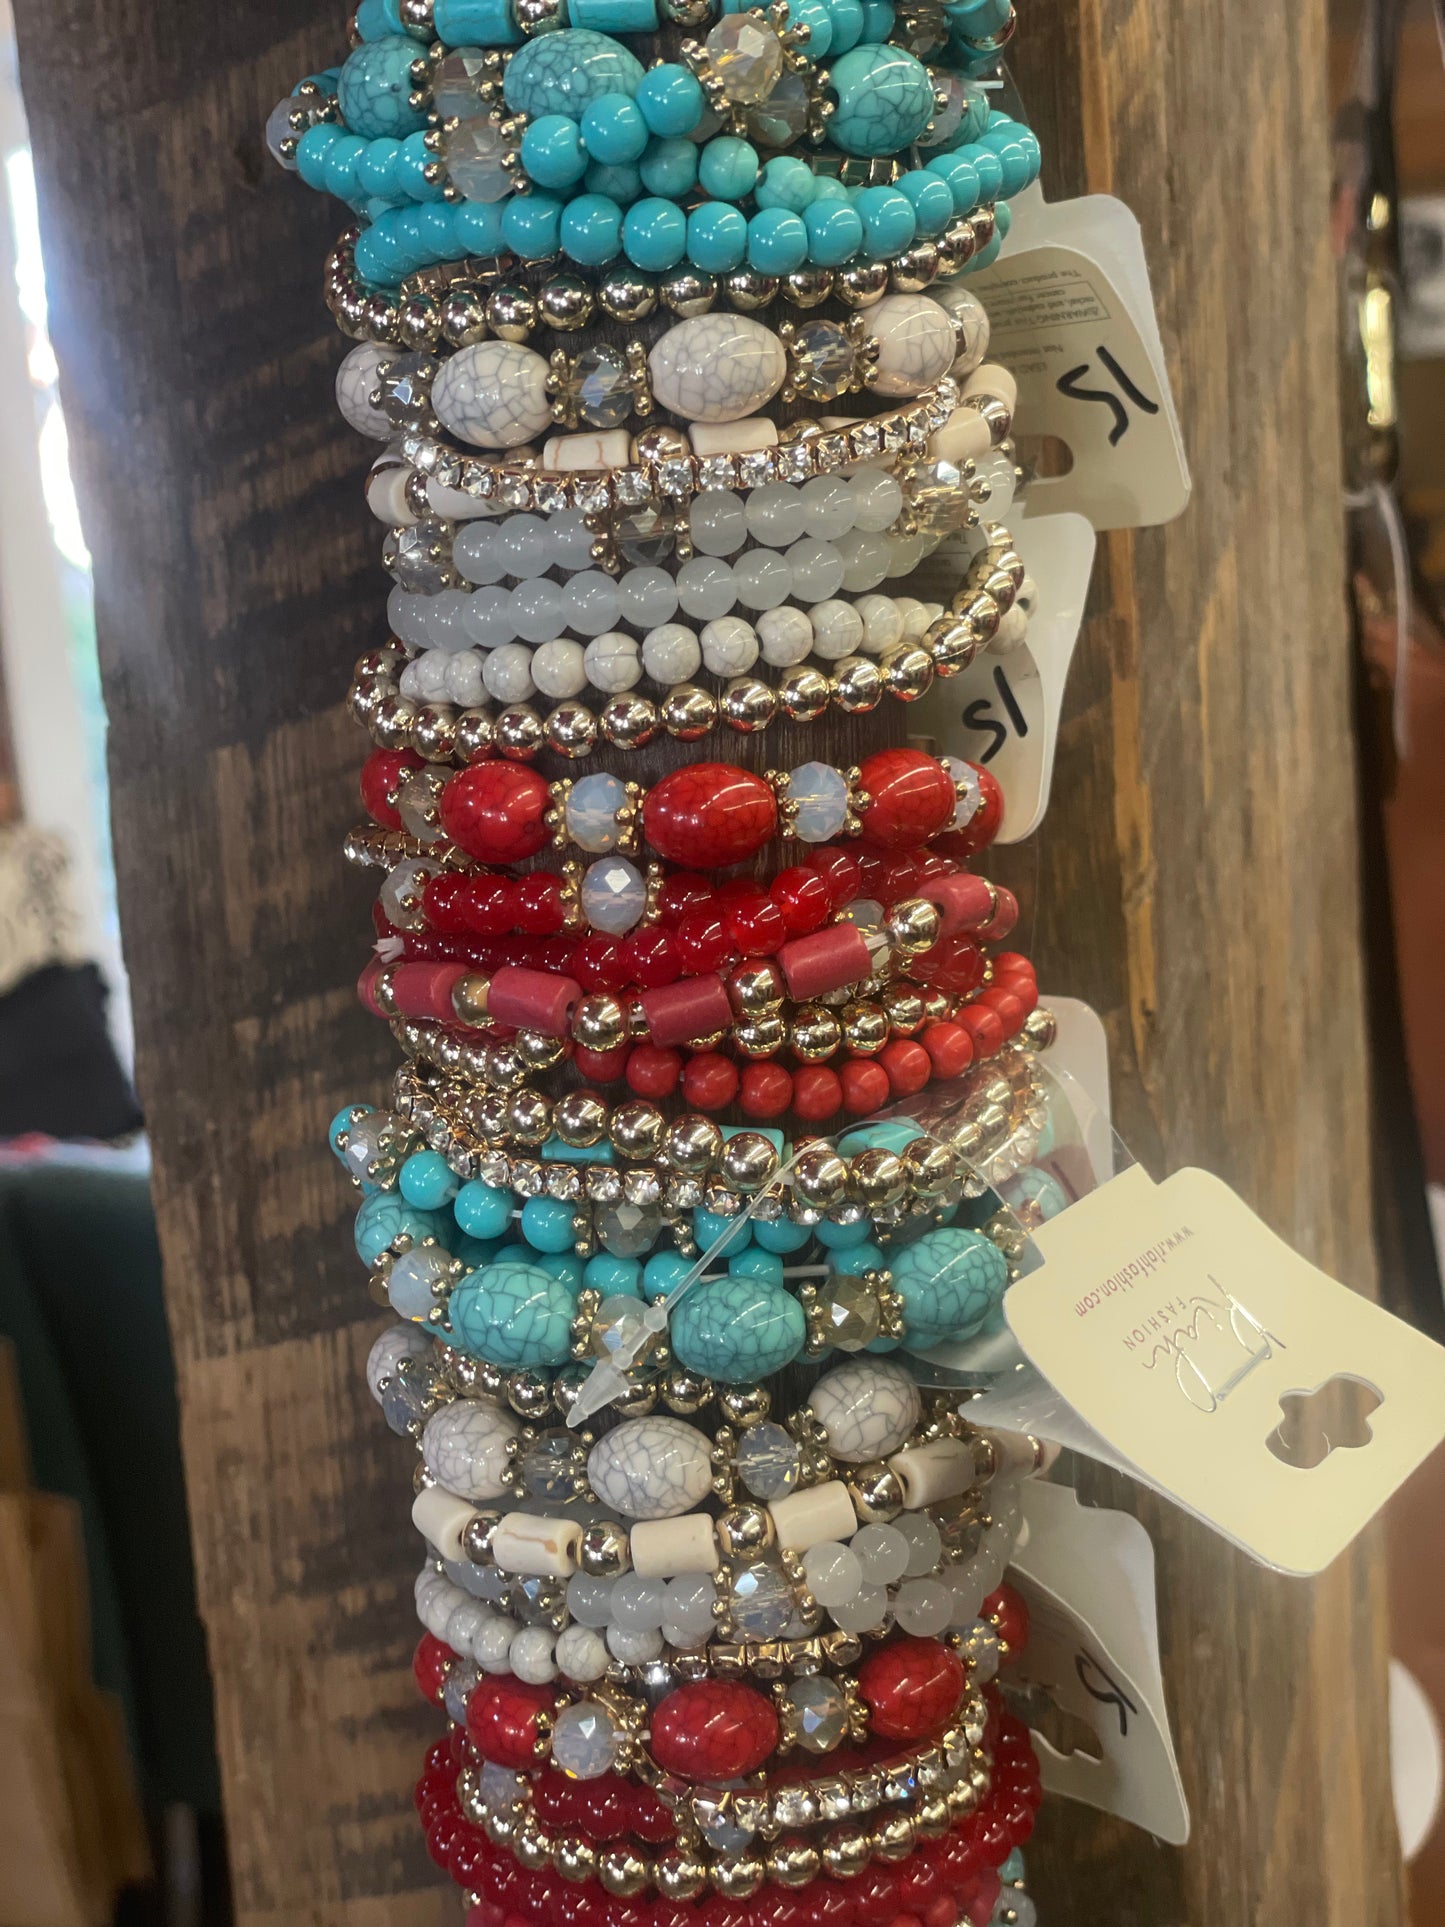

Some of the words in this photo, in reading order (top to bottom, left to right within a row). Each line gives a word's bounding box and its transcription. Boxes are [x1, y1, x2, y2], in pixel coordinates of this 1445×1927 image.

[1056, 345, 1159, 447] 15
[962, 665, 1028, 764] 15
[1075, 1226, 1194, 1317] www.riahfashion.com
[1123, 1297, 1187, 1351] FASHION
[1142, 1273, 1287, 1413] Riah
